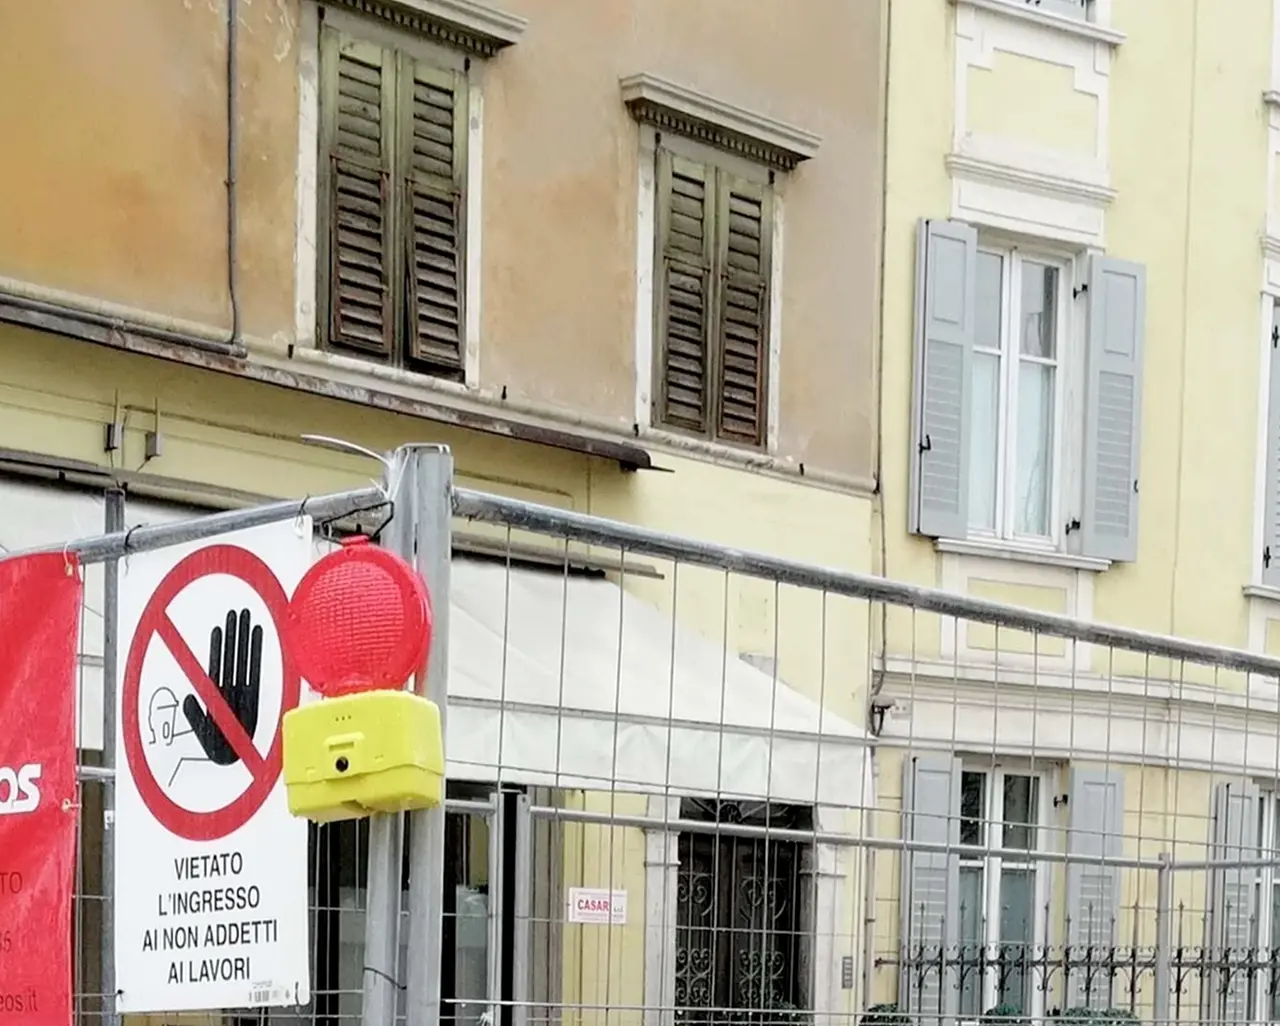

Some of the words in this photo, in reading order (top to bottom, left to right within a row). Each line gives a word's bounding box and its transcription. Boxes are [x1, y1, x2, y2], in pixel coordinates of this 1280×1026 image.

[174, 851, 243, 880] VIETATO
[158, 885, 260, 916] L'INGRESSO
[577, 899, 612, 911] CASAR
[142, 928, 157, 951] AI
[163, 926, 198, 950] NON
[204, 919, 277, 947] ADDETTI
[168, 961, 183, 984] AI
[189, 957, 250, 983] LAVORI
